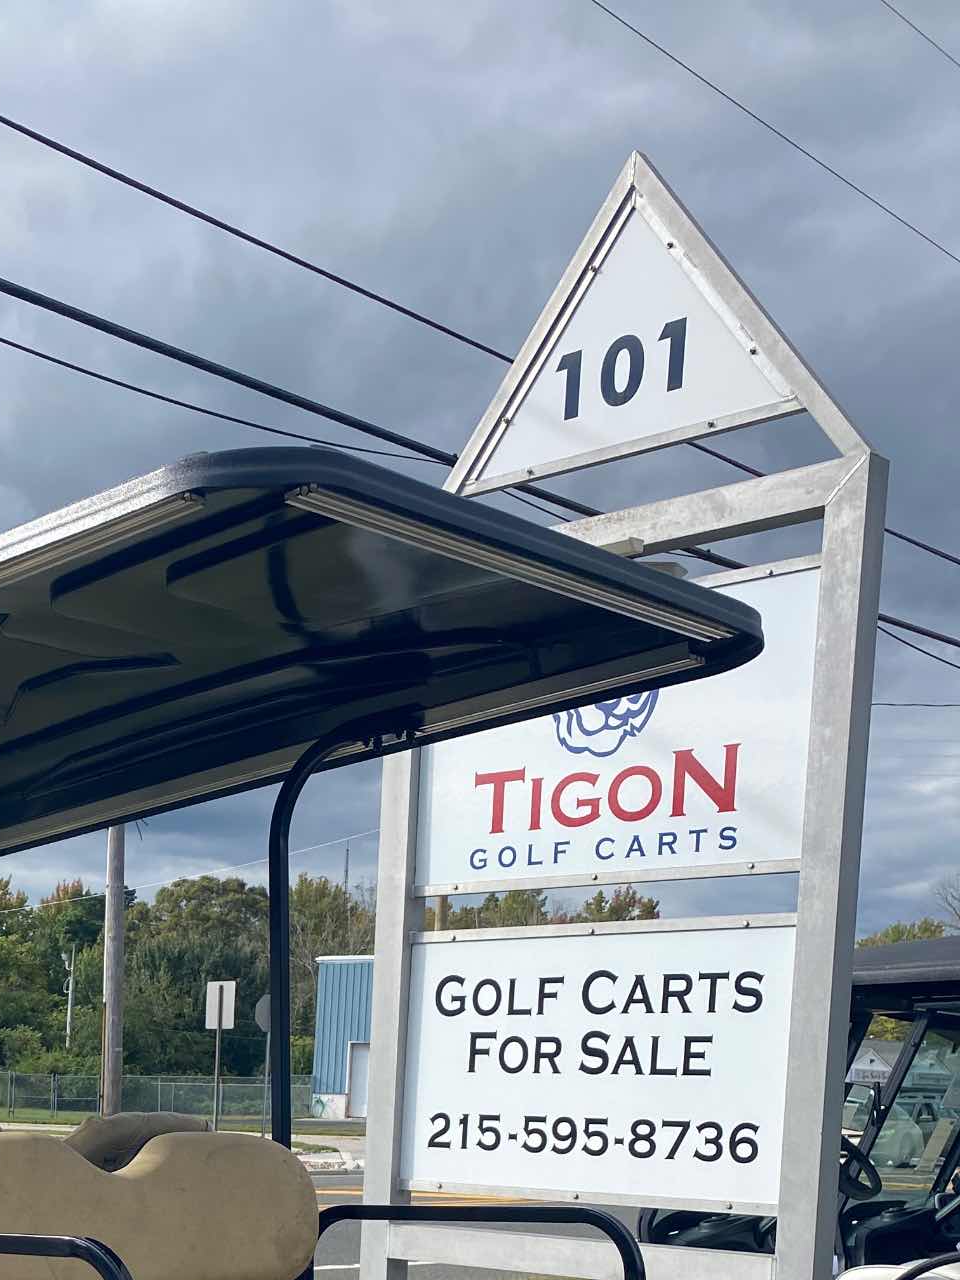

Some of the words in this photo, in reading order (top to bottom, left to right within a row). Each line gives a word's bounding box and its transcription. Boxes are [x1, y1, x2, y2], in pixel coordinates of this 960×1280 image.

[555, 317, 688, 421] 101
[474, 743, 741, 834] TIGON
[469, 841, 570, 870] GOLF
[595, 826, 739, 862] CARTS
[434, 975, 565, 1017] GOLF
[581, 970, 765, 1014] CARTS
[467, 1030, 563, 1074] FOR
[578, 1030, 714, 1077] SALE
[427, 1112, 761, 1164] 215-595-8736
